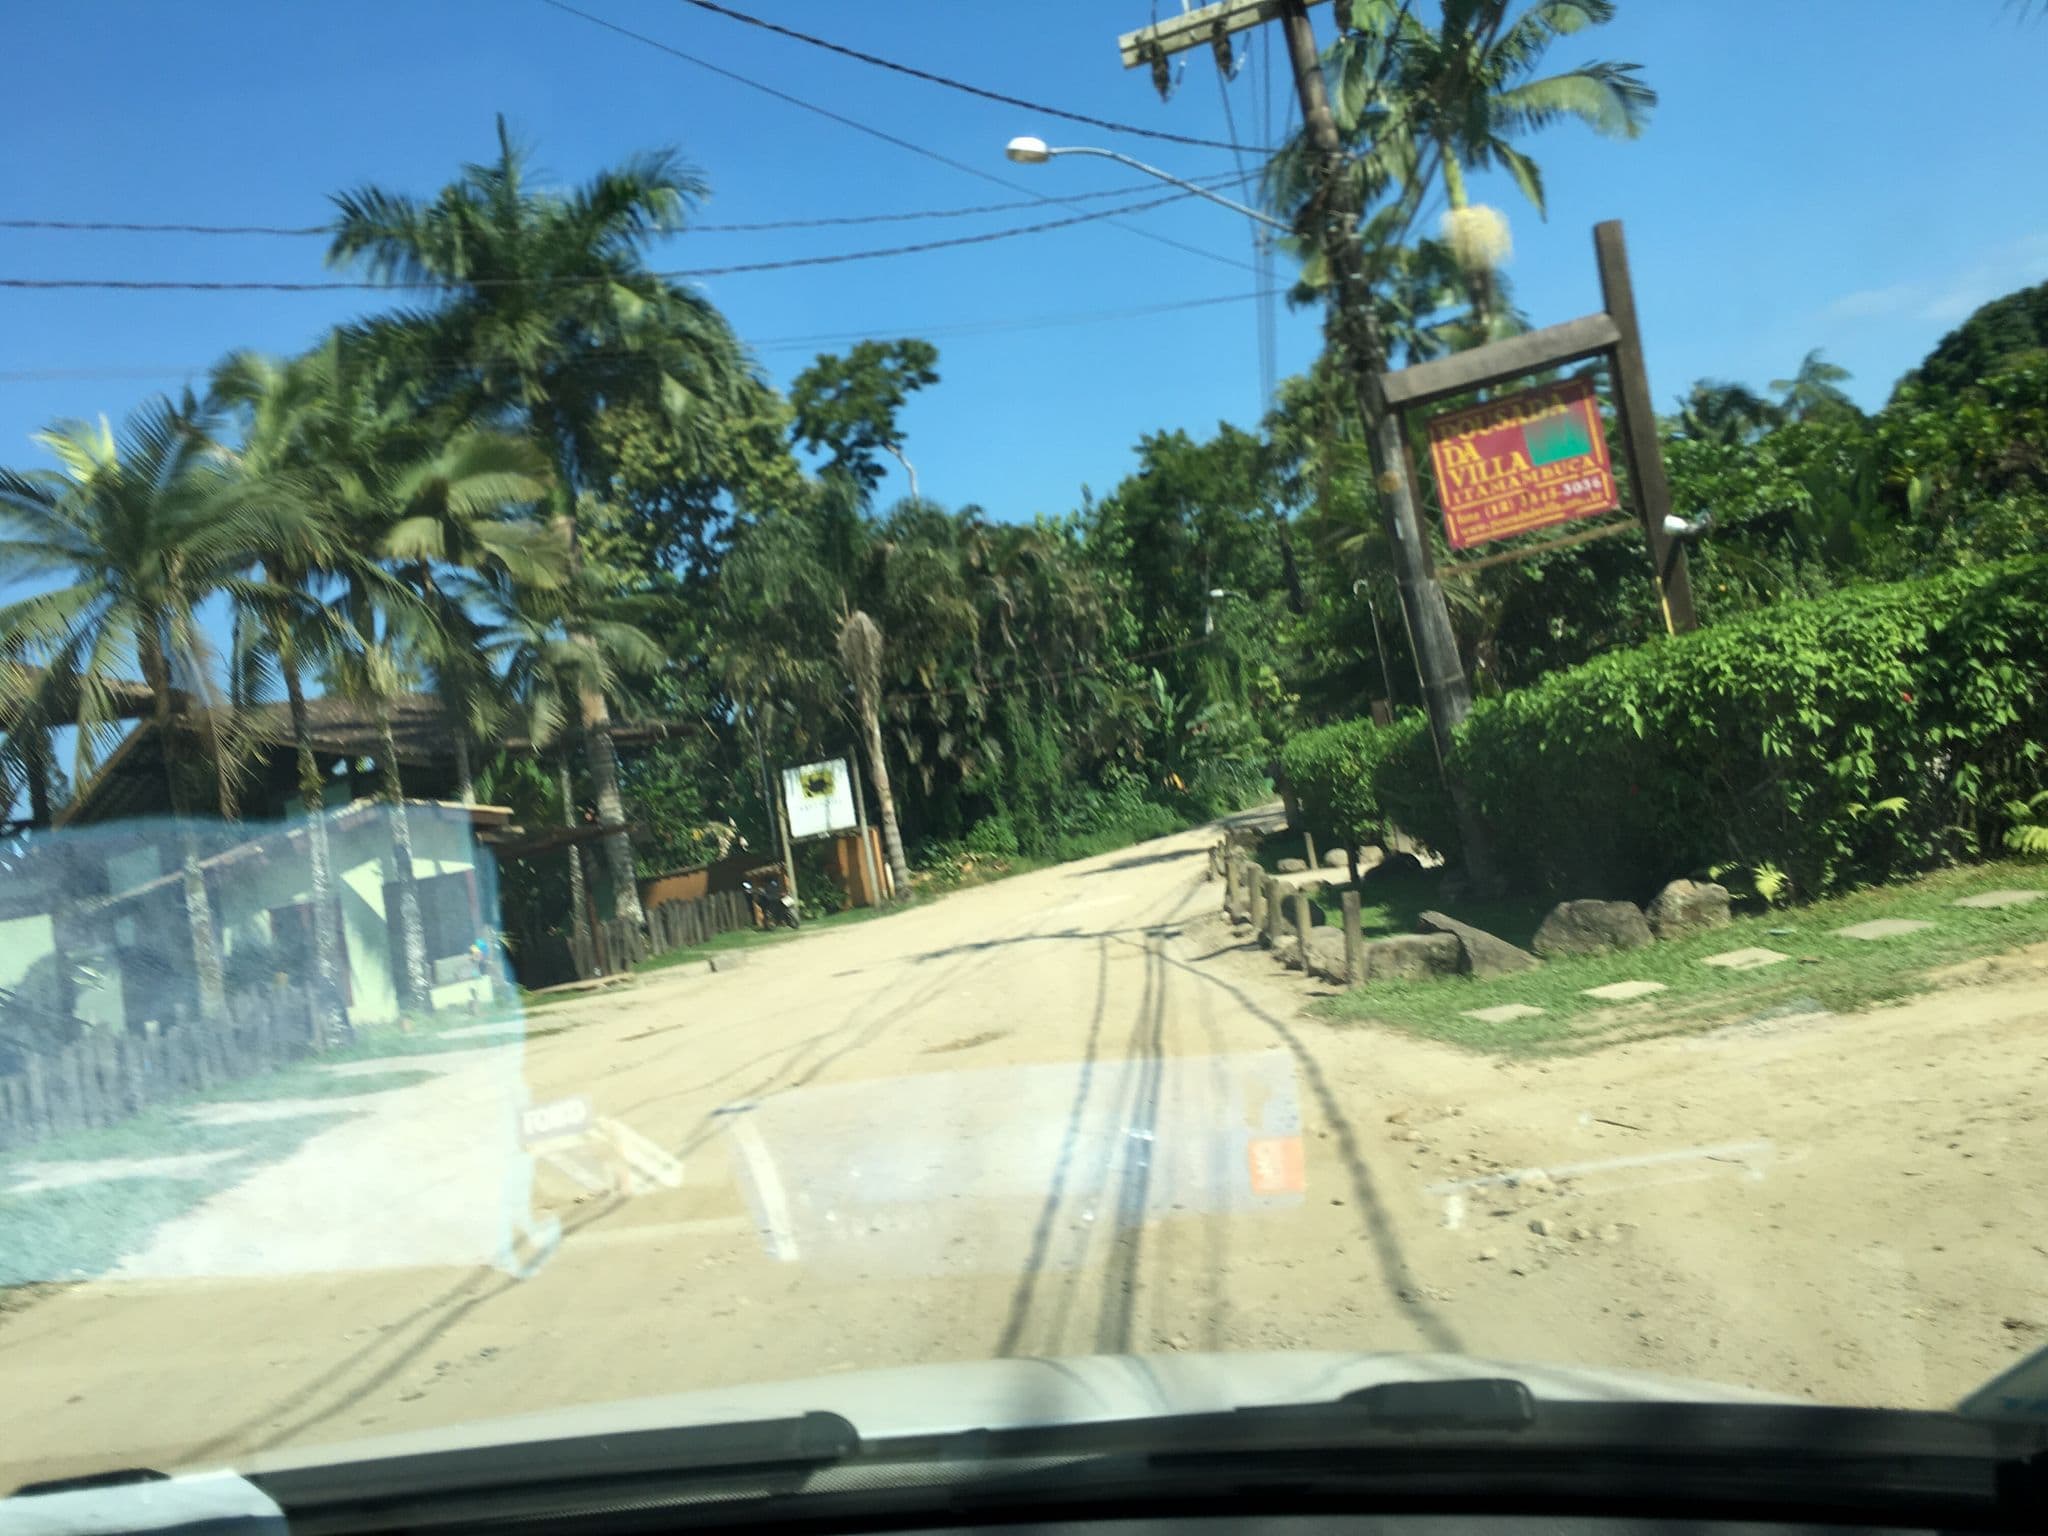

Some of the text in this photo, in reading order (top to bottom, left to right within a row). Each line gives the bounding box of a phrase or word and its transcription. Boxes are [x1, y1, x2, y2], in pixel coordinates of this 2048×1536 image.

[1438, 394, 1569, 445] POUSADA
[1442, 442, 1481, 469] DA
[1447, 452, 1530, 487] VILLA
[1453, 456, 1595, 503] ITAMAMBUCA
